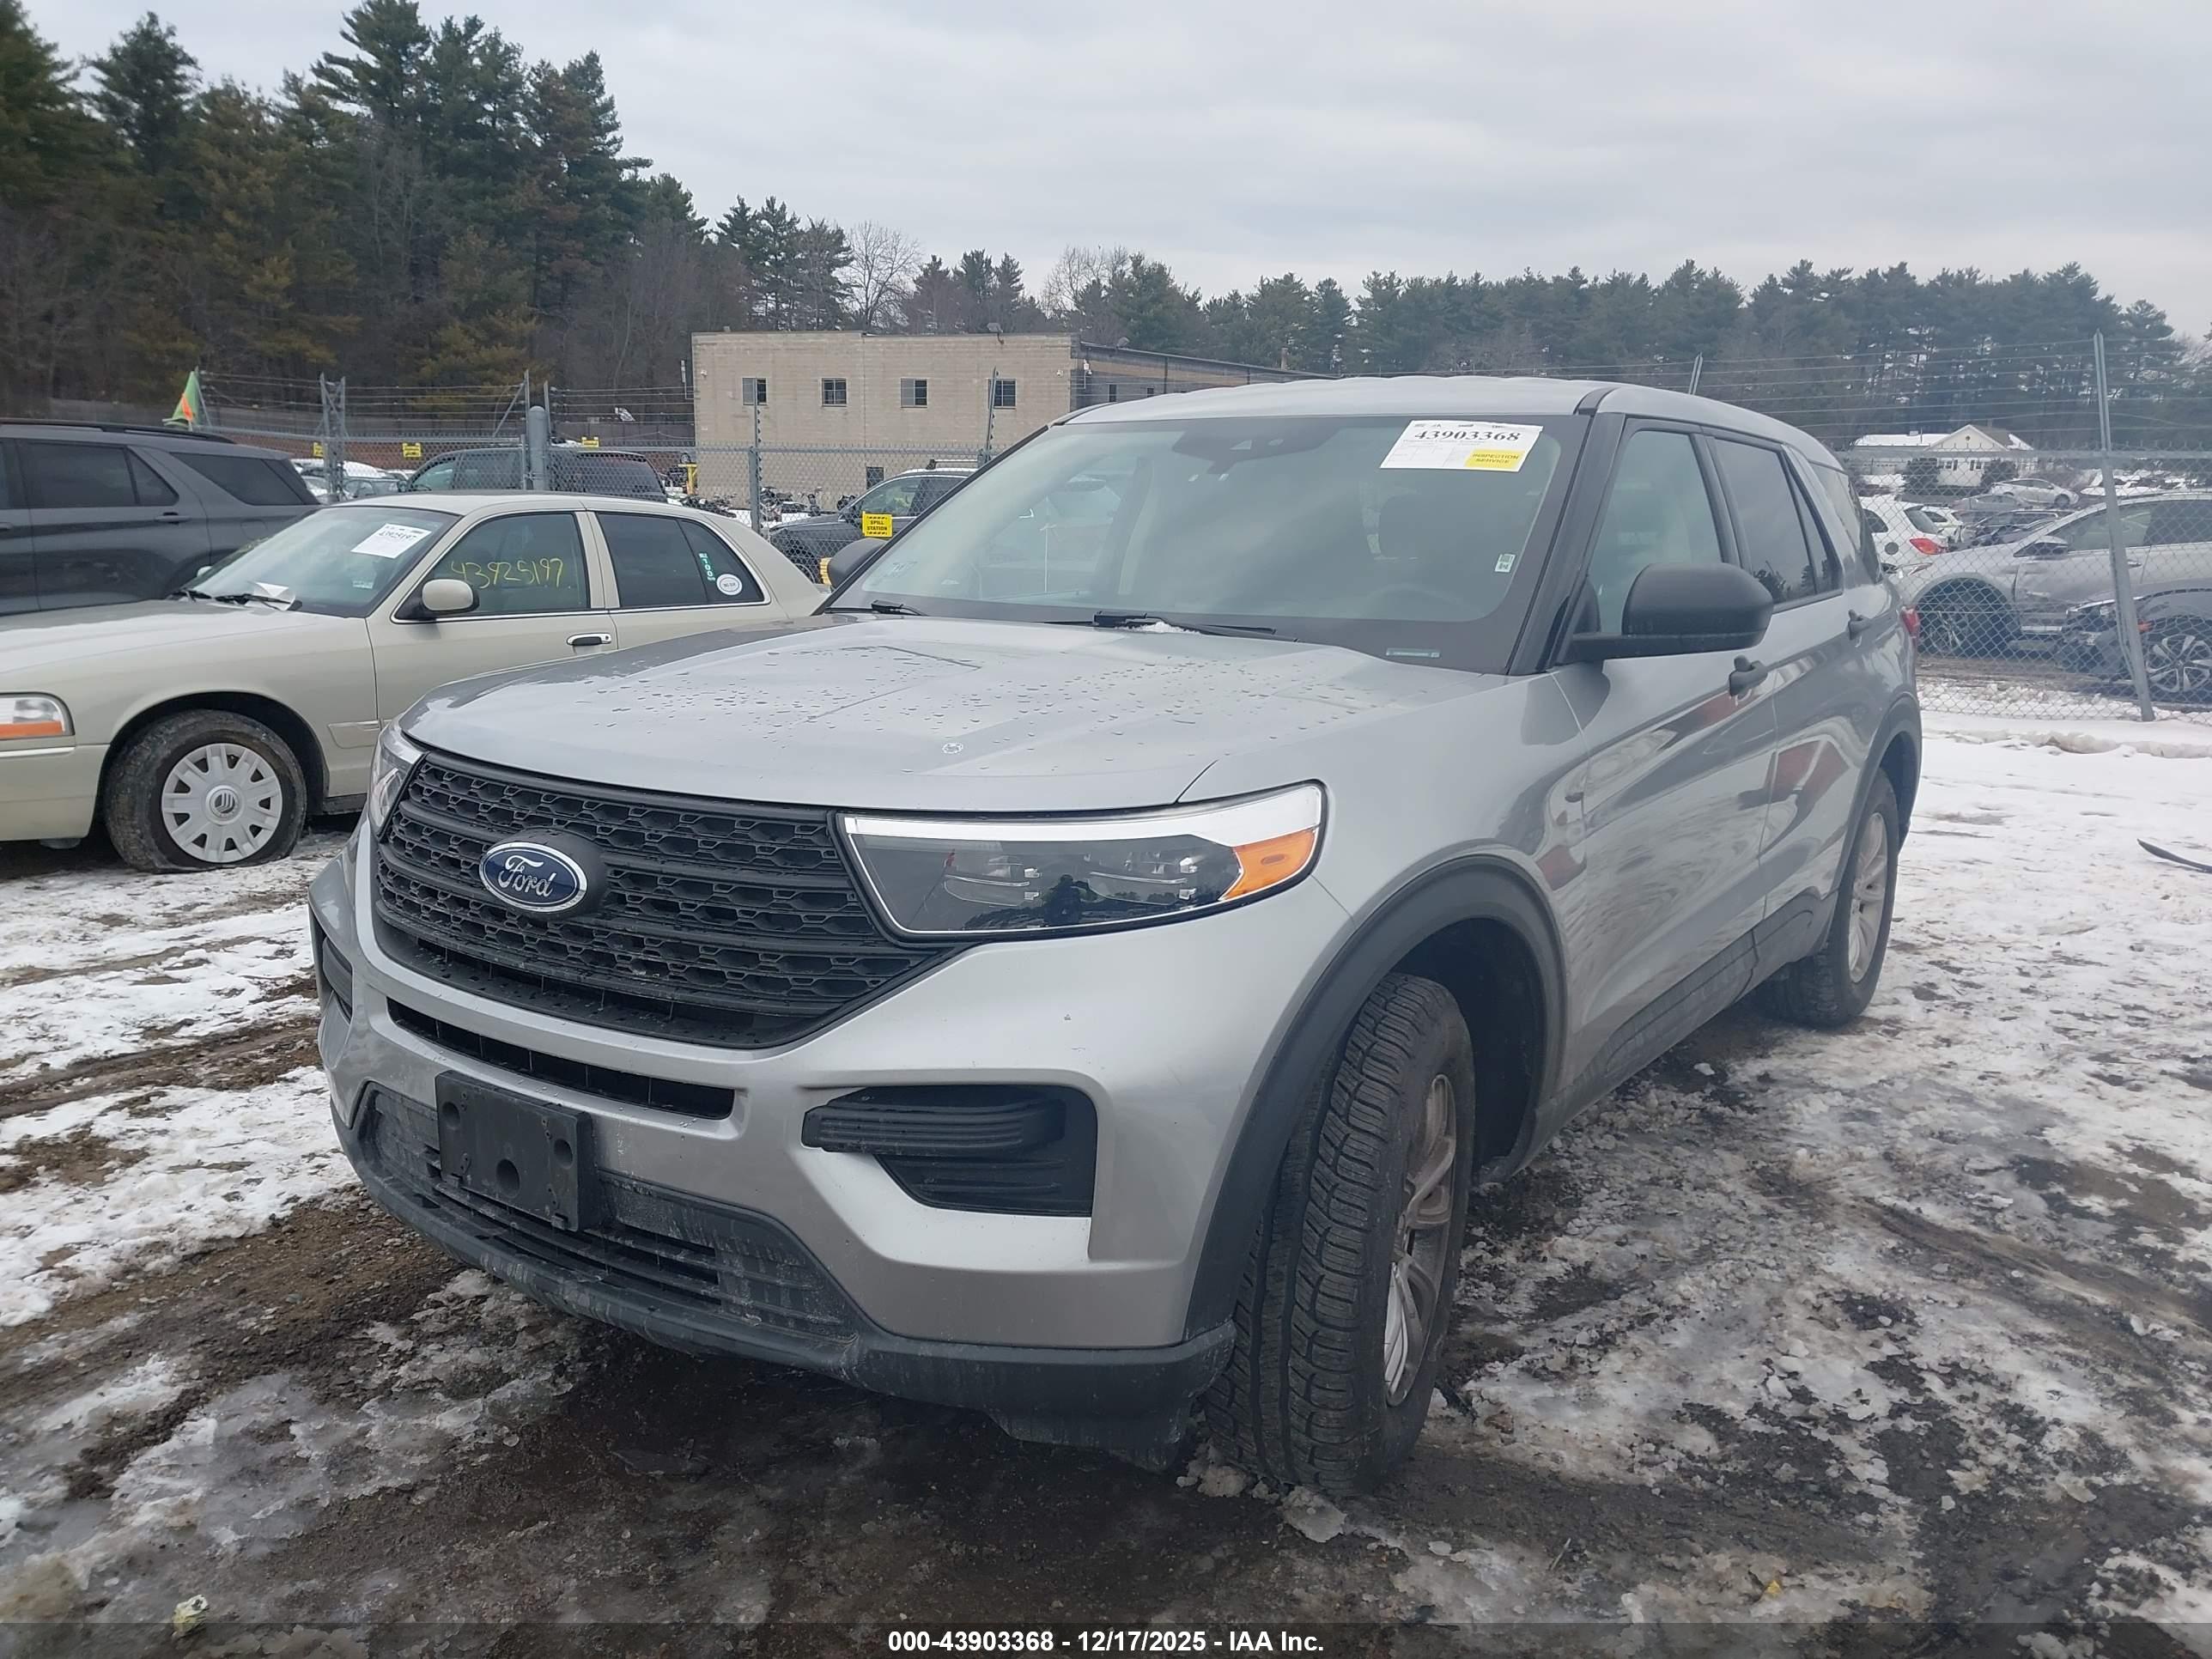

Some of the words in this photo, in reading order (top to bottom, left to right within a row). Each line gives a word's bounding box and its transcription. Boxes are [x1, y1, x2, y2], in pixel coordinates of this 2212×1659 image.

[1414, 430, 1521, 441] 43903368
[451, 558, 563, 589] 43925197
[497, 854, 557, 898] Ford
